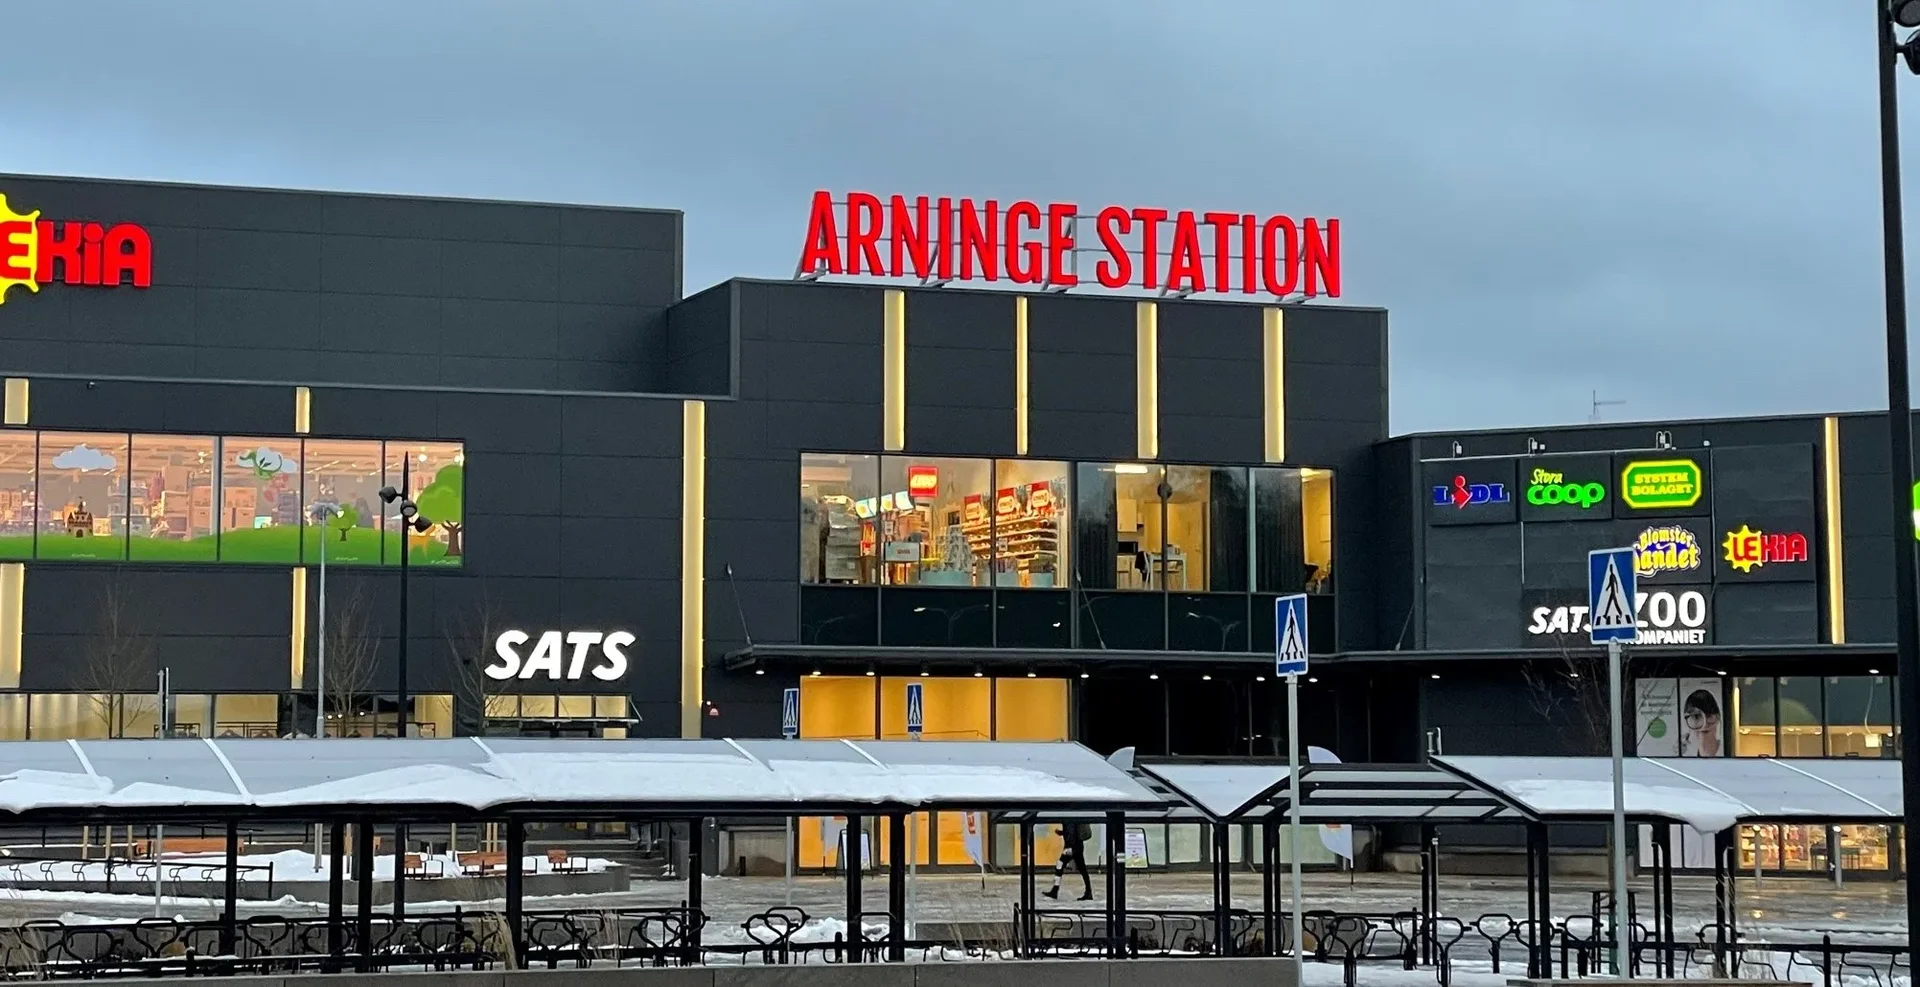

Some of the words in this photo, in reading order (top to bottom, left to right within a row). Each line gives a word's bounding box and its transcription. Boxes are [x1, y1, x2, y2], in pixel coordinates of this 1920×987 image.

[0, 220, 152, 289] EKiA
[802, 191, 1079, 286] ARNINGE
[1096, 207, 1341, 298] STATION
[1531, 468, 1563, 484] Stora
[1634, 472, 1689, 484] SYSTEM
[1630, 484, 1693, 496] BOLAGET
[1640, 526, 1693, 549] Blomster
[1528, 606, 1592, 634] SAT
[1627, 630, 1706, 645] OMPANIET
[484, 630, 636, 681] SATS
